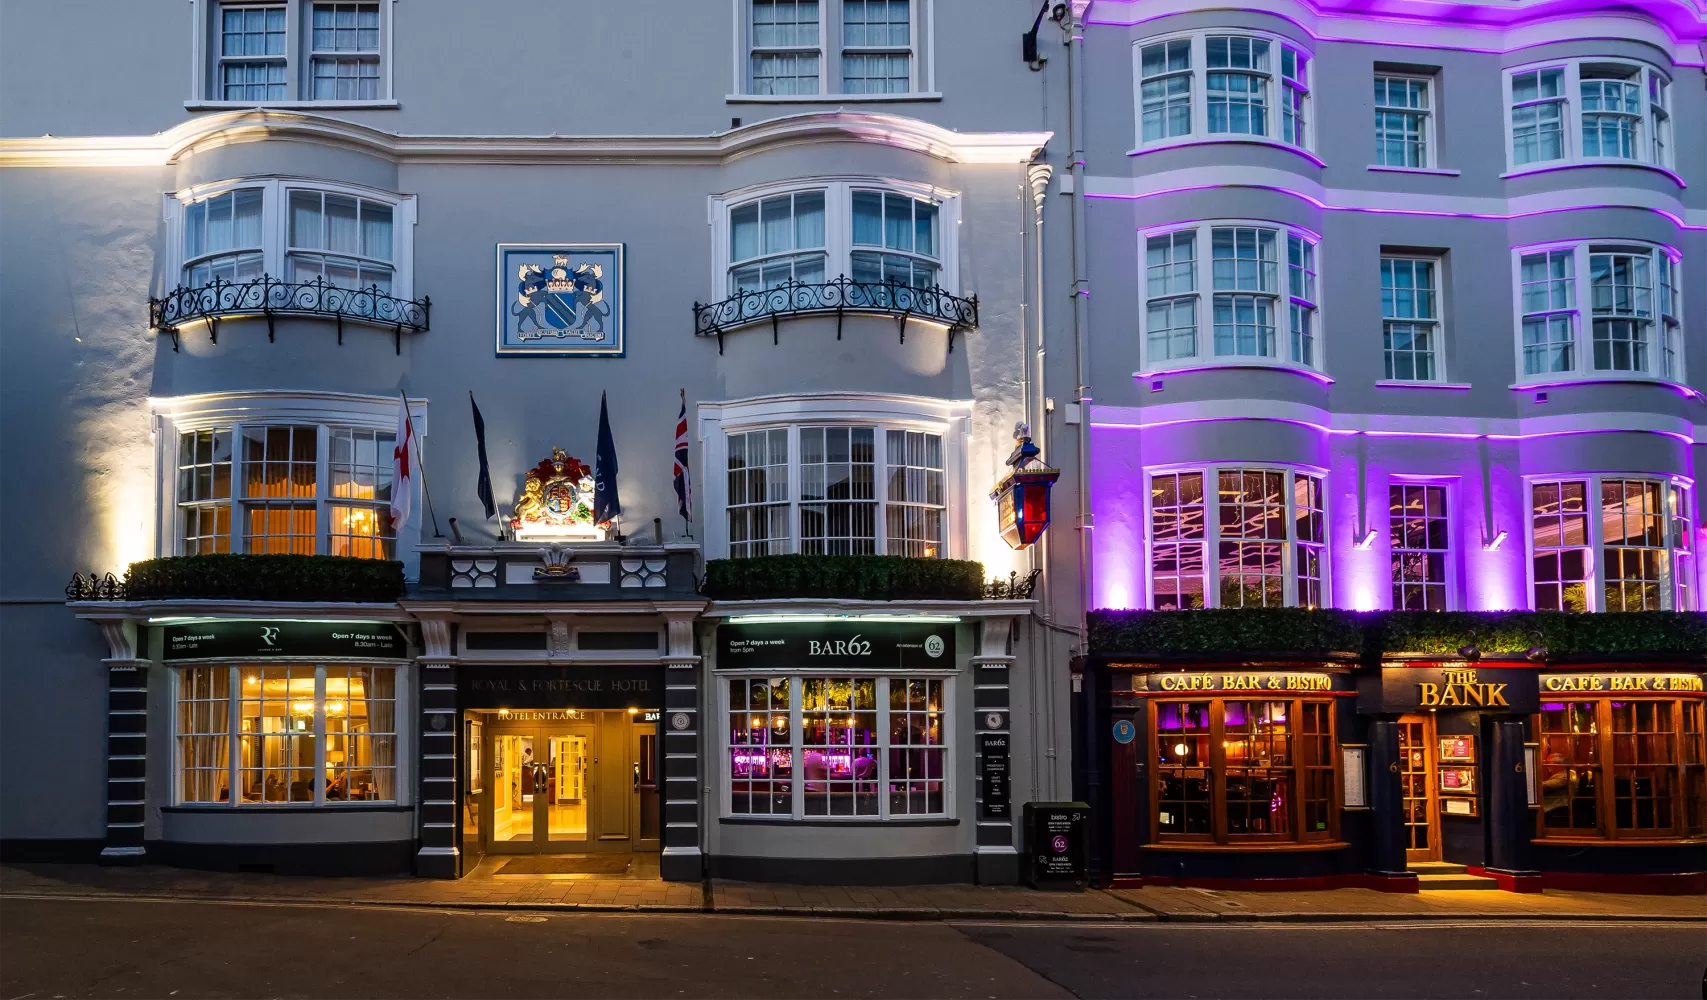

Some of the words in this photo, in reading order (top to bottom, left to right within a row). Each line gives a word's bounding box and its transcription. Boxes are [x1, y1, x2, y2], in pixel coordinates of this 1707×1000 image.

[808, 634, 872, 656] BAR62
[929, 638, 941, 650] 62
[1160, 672, 1215, 691] CAFÉ
[1222, 675, 1261, 690] BAR
[1267, 676, 1280, 690] &
[1286, 676, 1332, 690] BISTRO
[1444, 669, 1478, 684] THE
[1546, 674, 1603, 691] CAFÉ
[1608, 676, 1648, 690] BAR
[1652, 677, 1666, 690] &
[472, 680, 512, 691] ROYAL
[519, 680, 528, 692] &
[533, 680, 603, 691] FORTESCUE
[612, 680, 651, 691] HOTEL
[1419, 682, 1509, 706] BANK
[498, 712, 530, 720] HOTEL
[532, 712, 585, 720] ENTRANCE
[1054, 838, 1065, 848] 62
